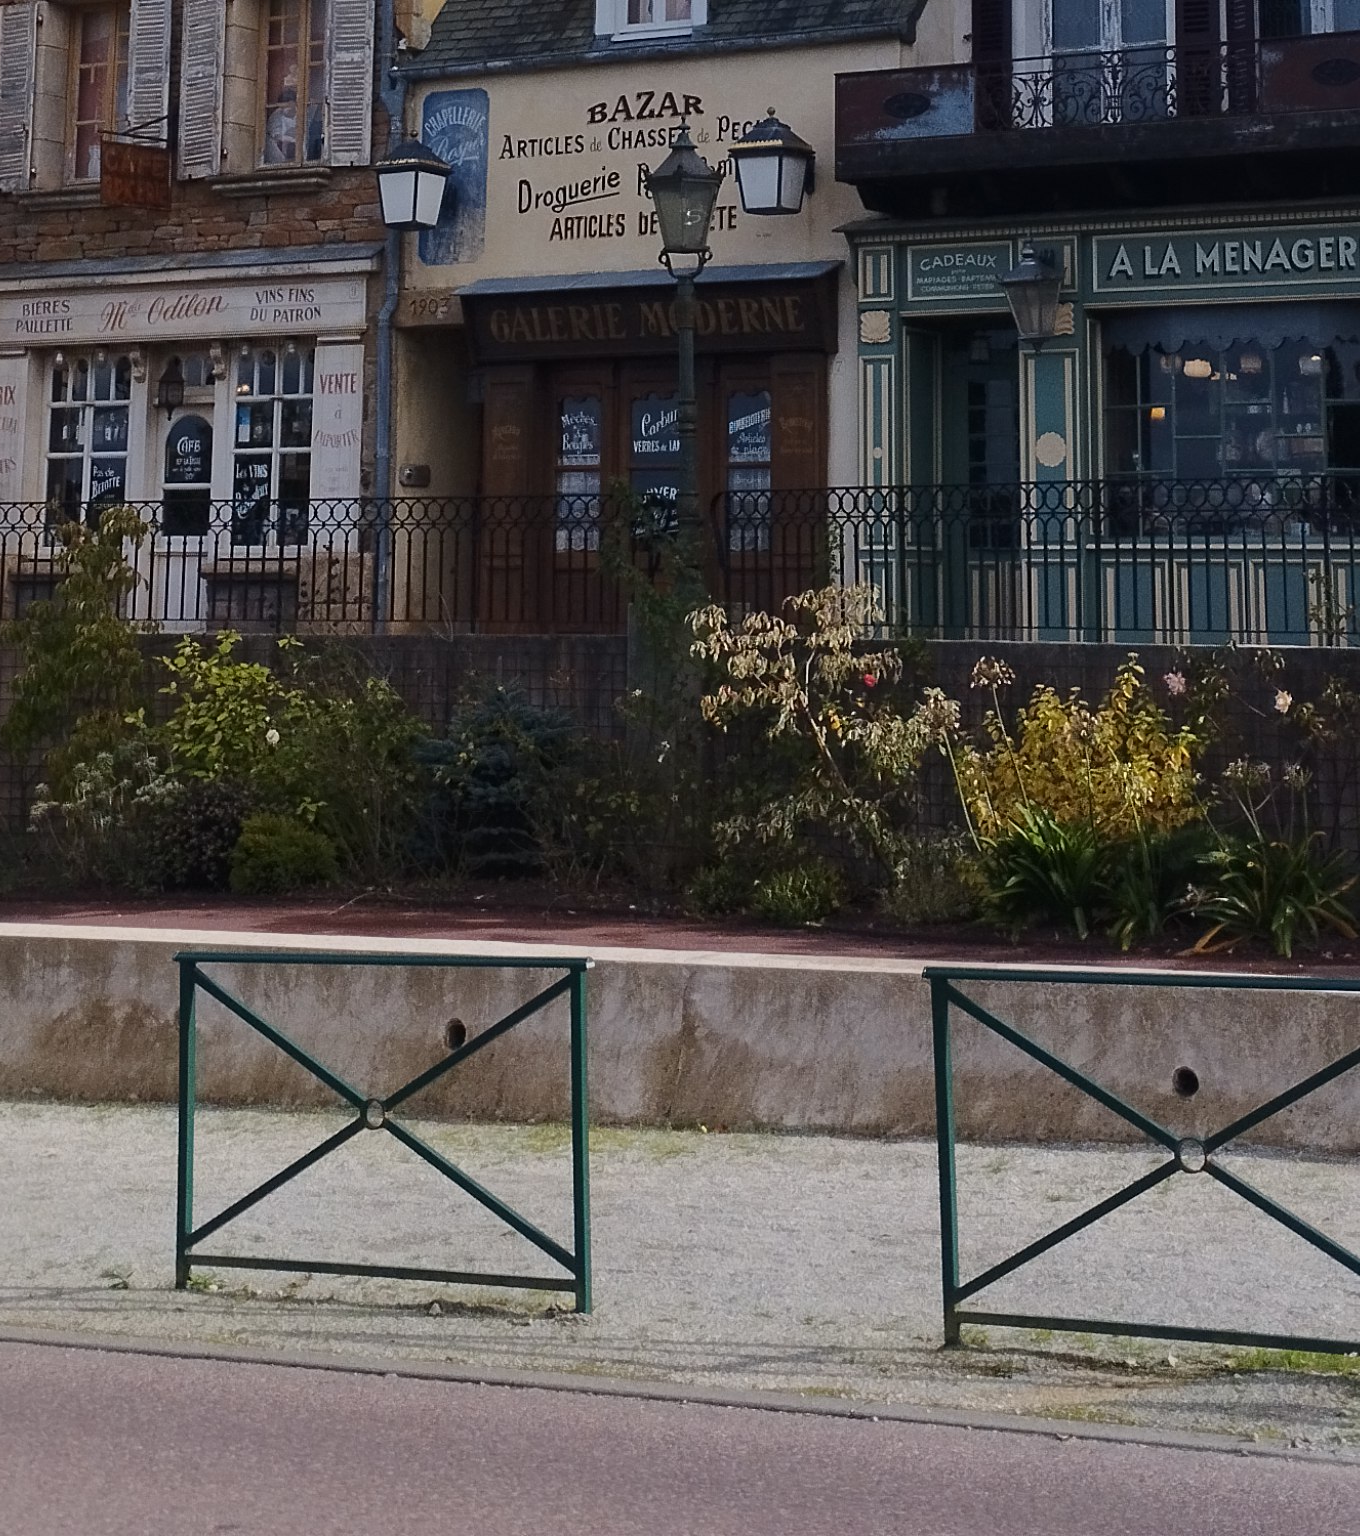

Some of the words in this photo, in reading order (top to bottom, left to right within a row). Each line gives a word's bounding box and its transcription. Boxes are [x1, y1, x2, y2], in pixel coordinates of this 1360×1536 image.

[424, 106, 486, 137] CHAPELLERIE
[587, 91, 704, 124] BAZAR
[499, 134, 584, 160] ARTICLES
[590, 137, 602, 152] de
[607, 127, 678, 151] CHASSE
[697, 127, 710, 143] de
[518, 165, 621, 213] Droguerie
[549, 213, 625, 241] ARTICLES
[920, 253, 997, 270] CADEAUX
[1110, 244, 1133, 277] A
[1145, 242, 1181, 275] LA
[147, 293, 229, 325] Odilon
[255, 289, 284, 305] VINS
[290, 288, 315, 304] FINS
[15, 317, 72, 333] PAILLETTE
[250, 308, 267, 323] DU
[273, 306, 322, 323] PATRON
[490, 303, 626, 343] GALERIE
[320, 372, 357, 394] VENTE
[633, 439, 660, 453] VERRES
